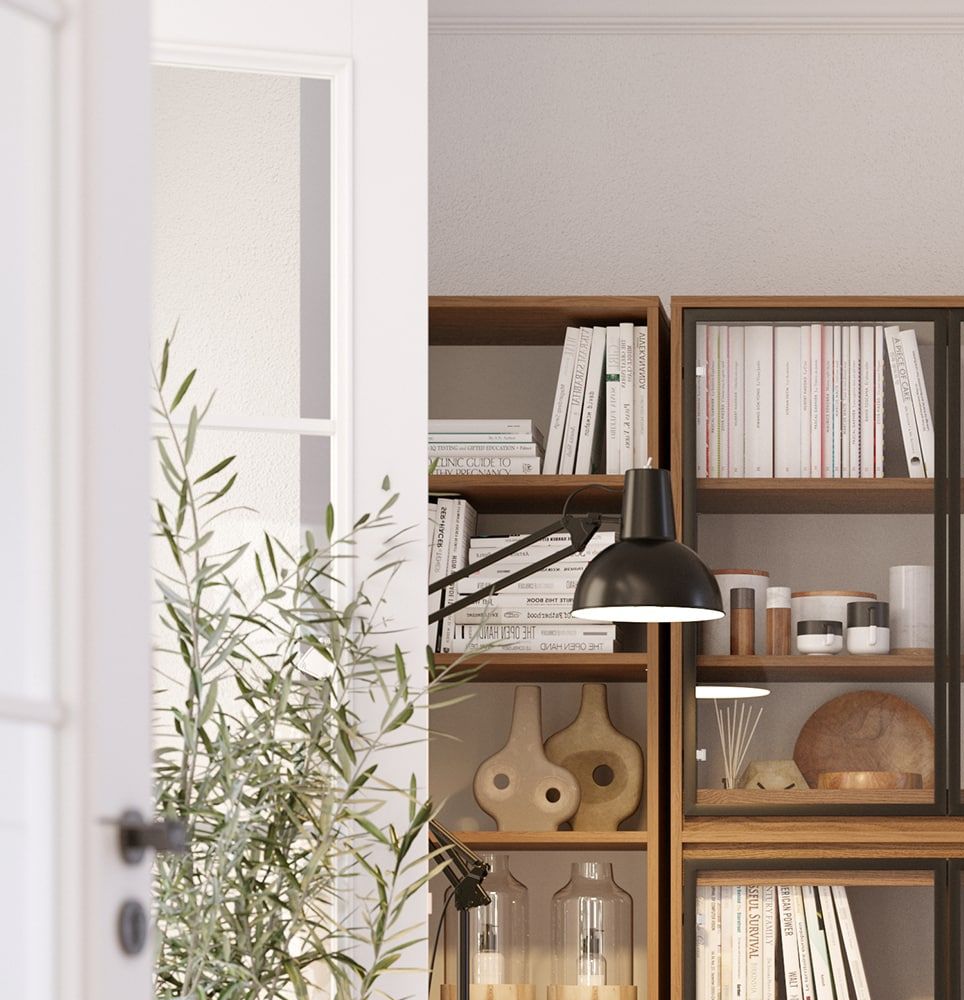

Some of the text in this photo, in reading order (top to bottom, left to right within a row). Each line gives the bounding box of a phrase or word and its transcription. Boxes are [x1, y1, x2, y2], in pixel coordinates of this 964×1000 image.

[894, 344, 904, 367] PIECE
[898, 368, 906, 379] OF
[900, 380, 910, 401] CAKE
[466, 457, 494, 467] GUIDE
[499, 457, 511, 467] TO
[765, 915, 773, 945] FAMILY
[782, 912, 793, 936] POWER
[747, 914, 760, 959] SURVIVAL
